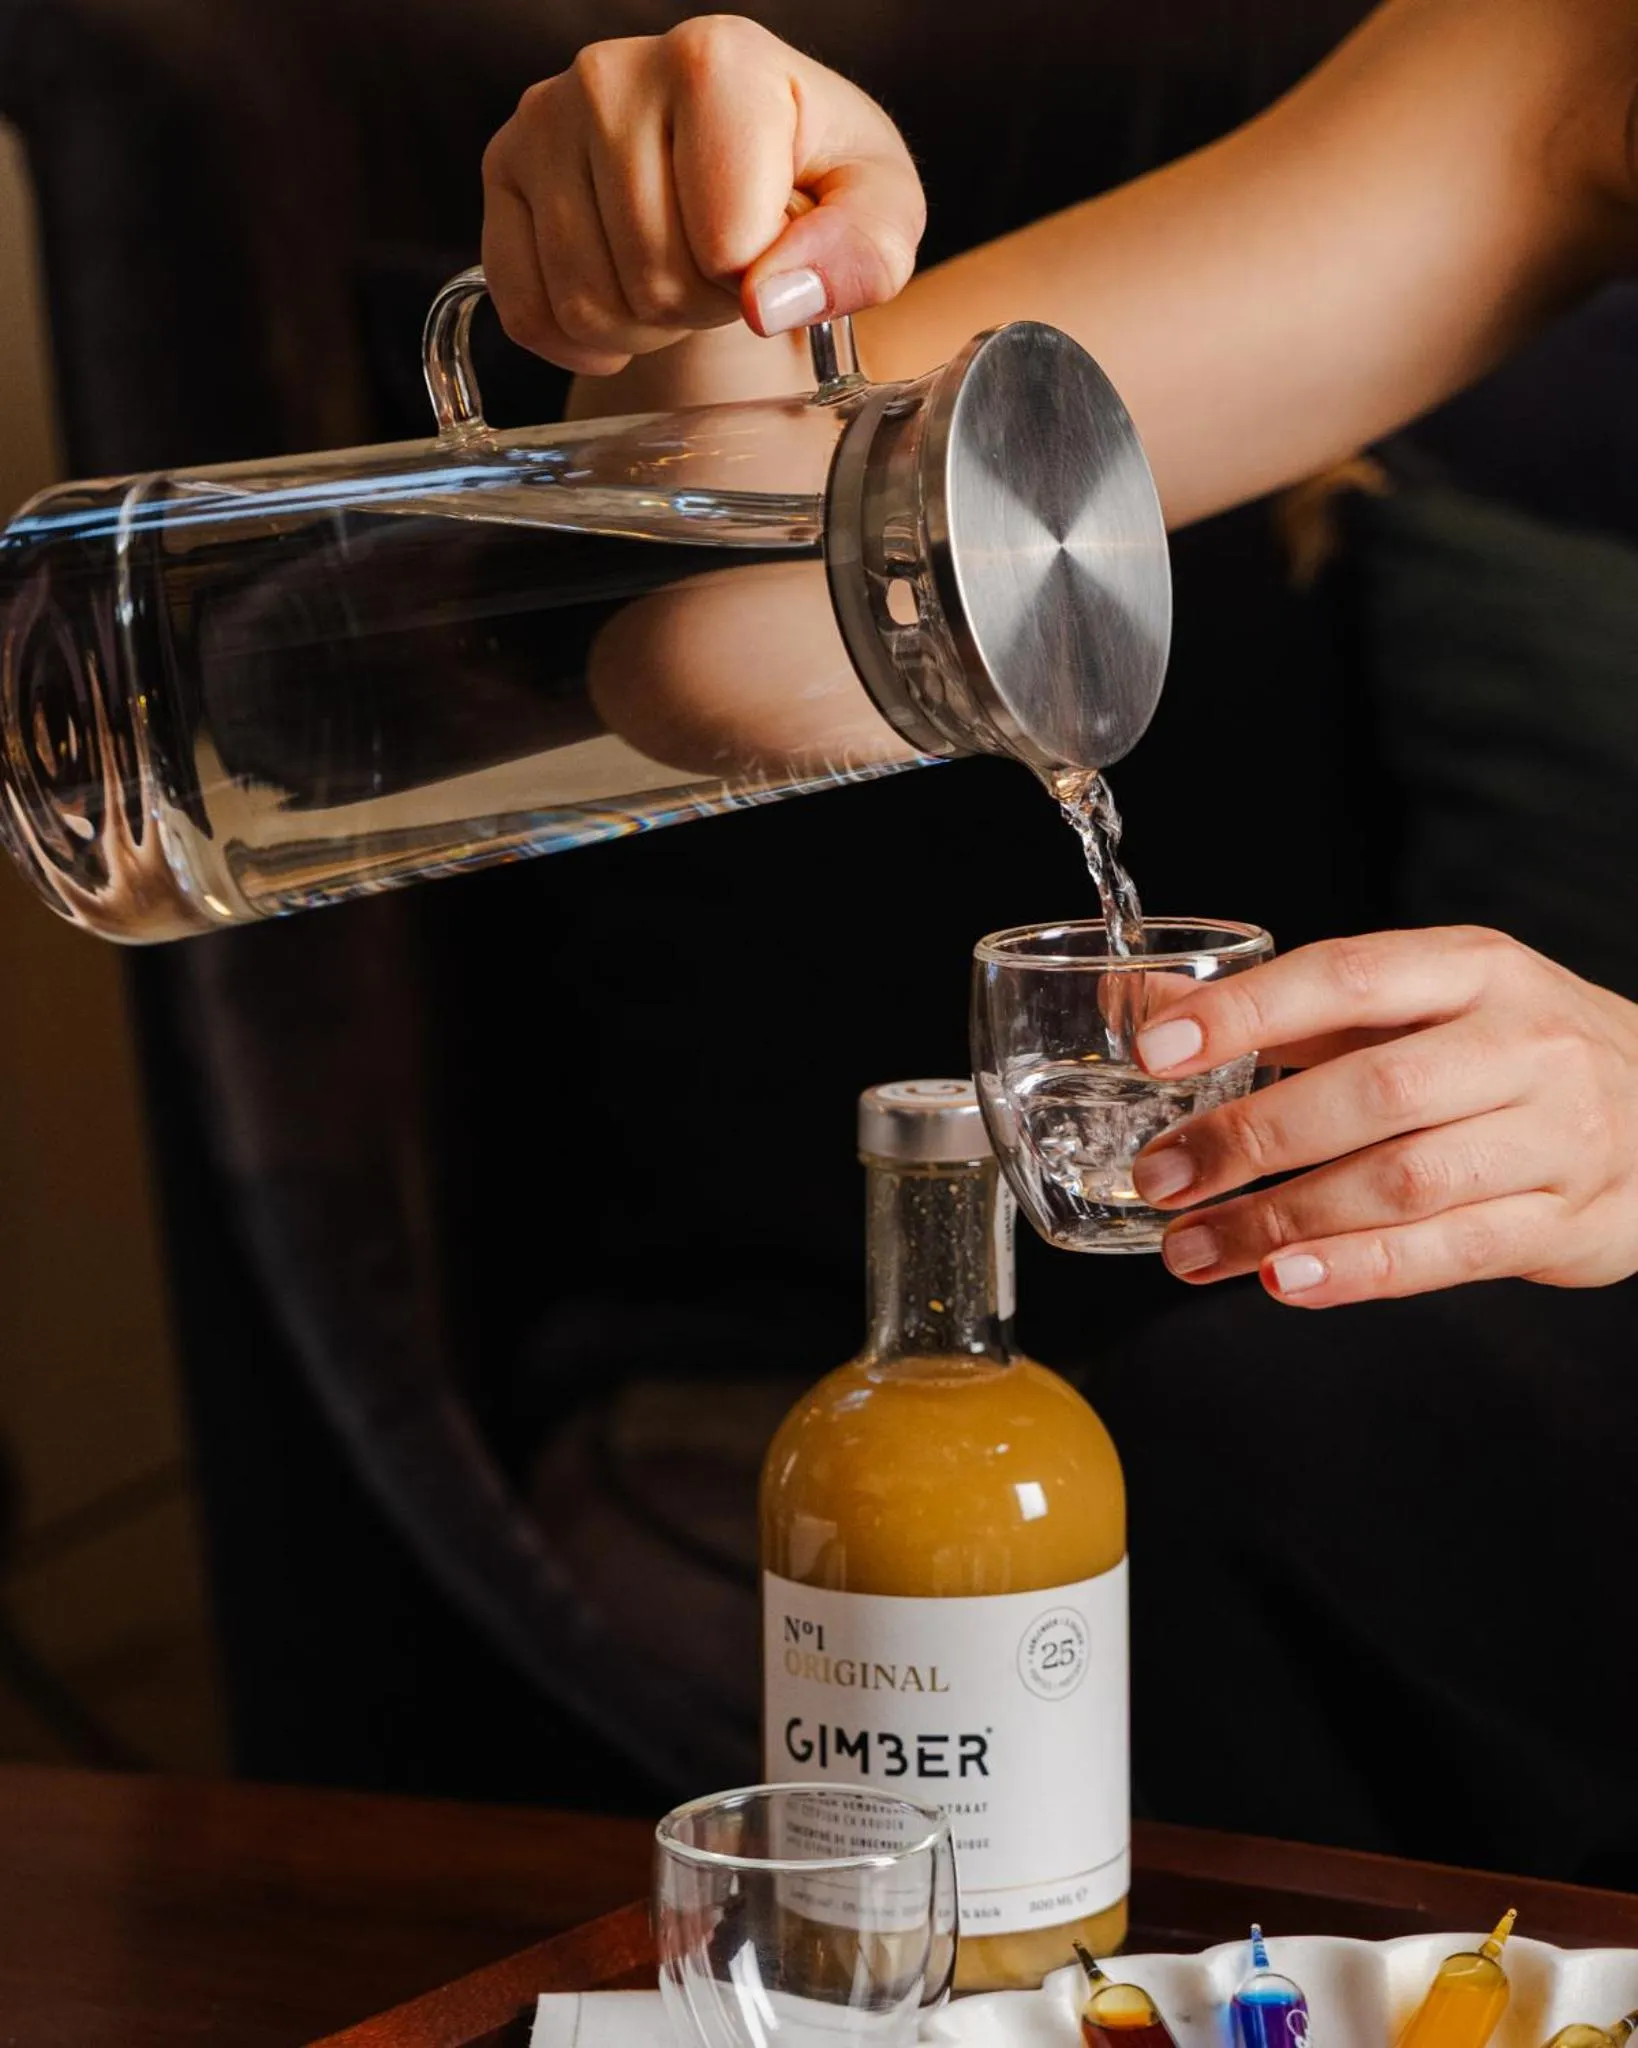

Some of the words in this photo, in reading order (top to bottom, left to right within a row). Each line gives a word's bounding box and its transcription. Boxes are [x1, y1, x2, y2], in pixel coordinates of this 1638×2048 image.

[783, 1649, 950, 1693] ORIGINAL
[1041, 1639, 1075, 1670] 25
[785, 1717, 992, 1779] GIMBER
